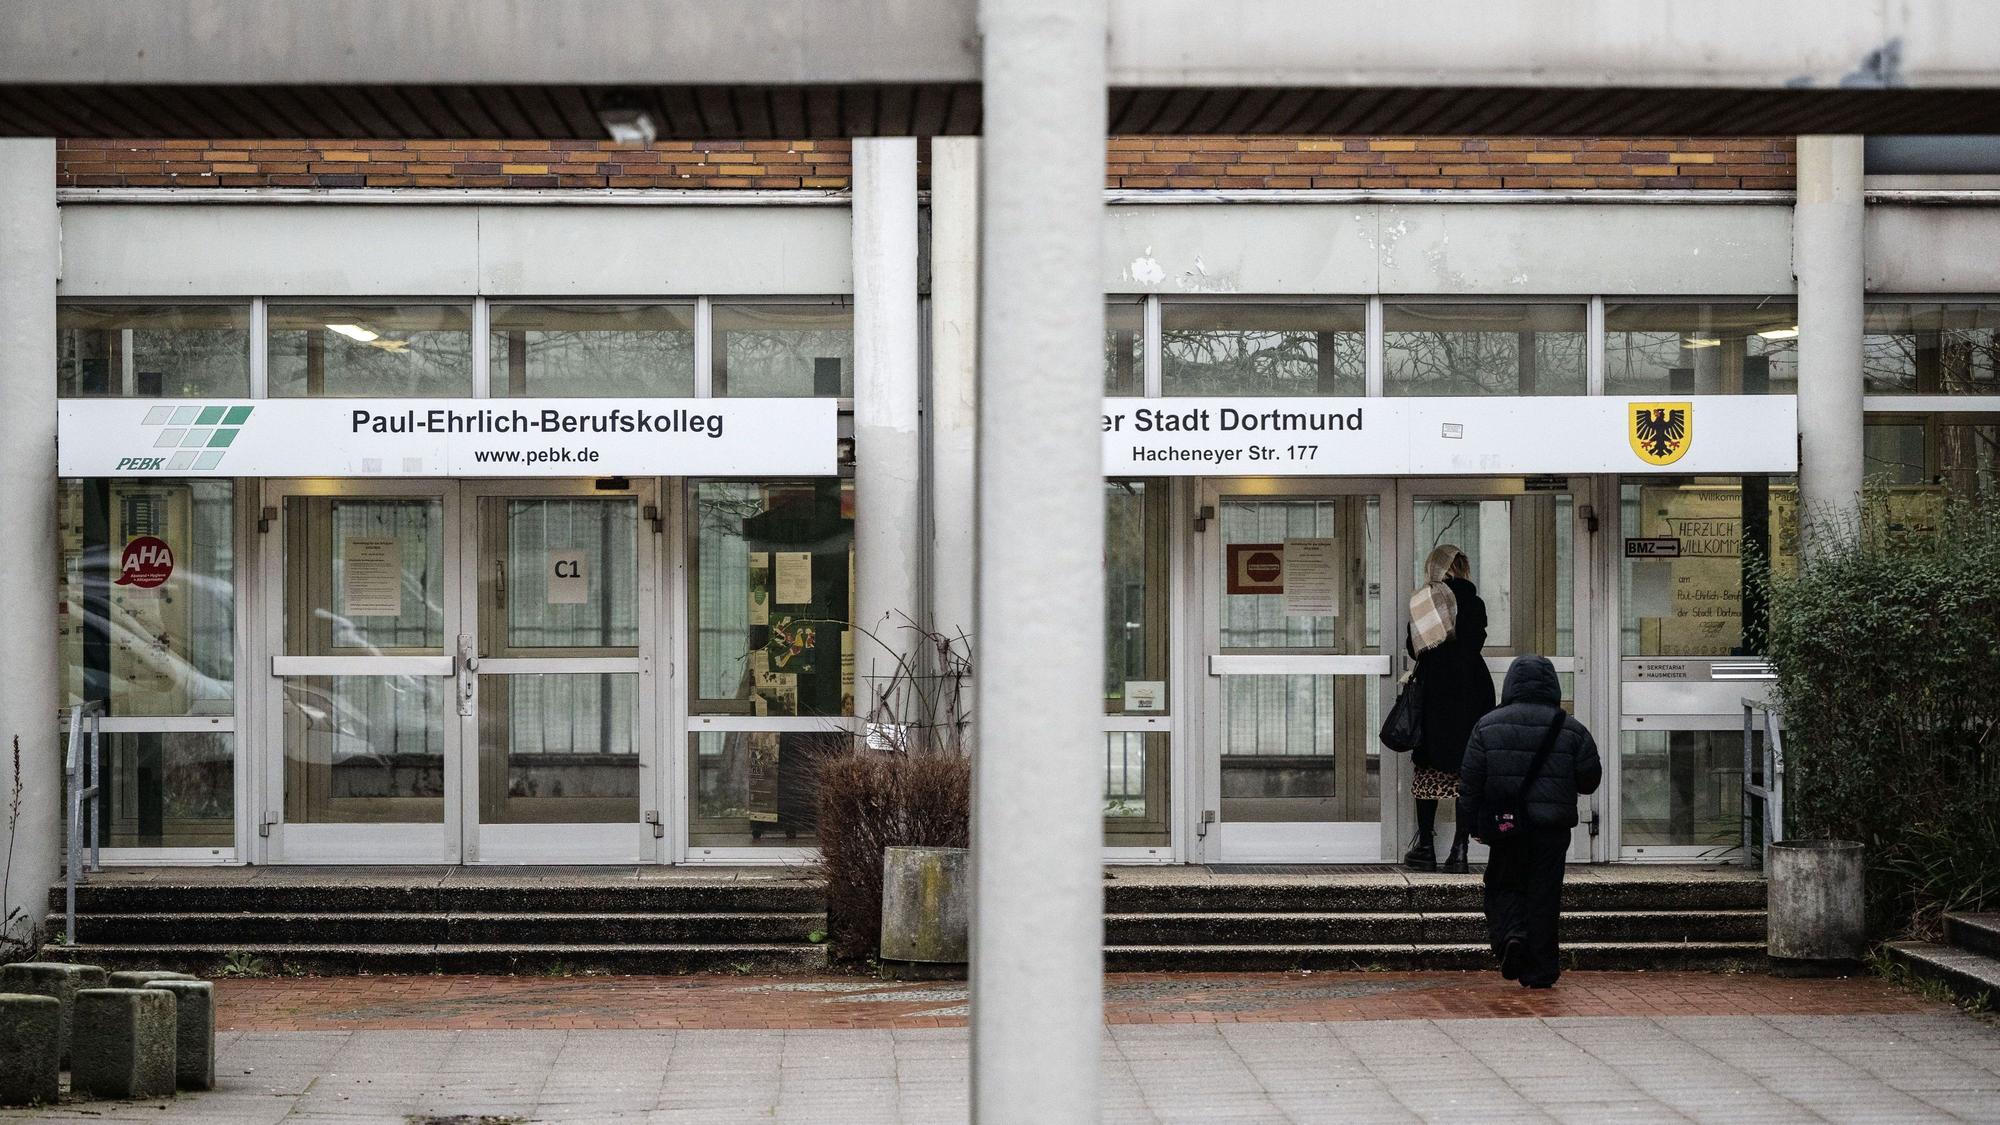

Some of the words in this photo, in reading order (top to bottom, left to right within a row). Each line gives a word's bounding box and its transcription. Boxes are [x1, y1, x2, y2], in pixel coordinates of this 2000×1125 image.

[352, 409, 724, 438] Paul-Ehrlich-Berufskolleg
[1101, 414, 1125, 432] er
[1134, 408, 1210, 431] Stadt
[1220, 408, 1362, 431] Dortmund
[115, 457, 166, 470] PEBK
[475, 447, 599, 465] www.pebk.de
[1132, 446, 1242, 464] Hacheneyer
[1248, 445, 1280, 460] Str.
[1287, 445, 1318, 460] 177
[1698, 493, 1742, 501] Willkomm
[1680, 522, 1733, 537] HERZLICH
[1628, 542, 1655, 553] BMZ
[1680, 539, 1741, 554] WILLKOMM
[123, 545, 171, 572] AHA
[554, 560, 581, 578] C1
